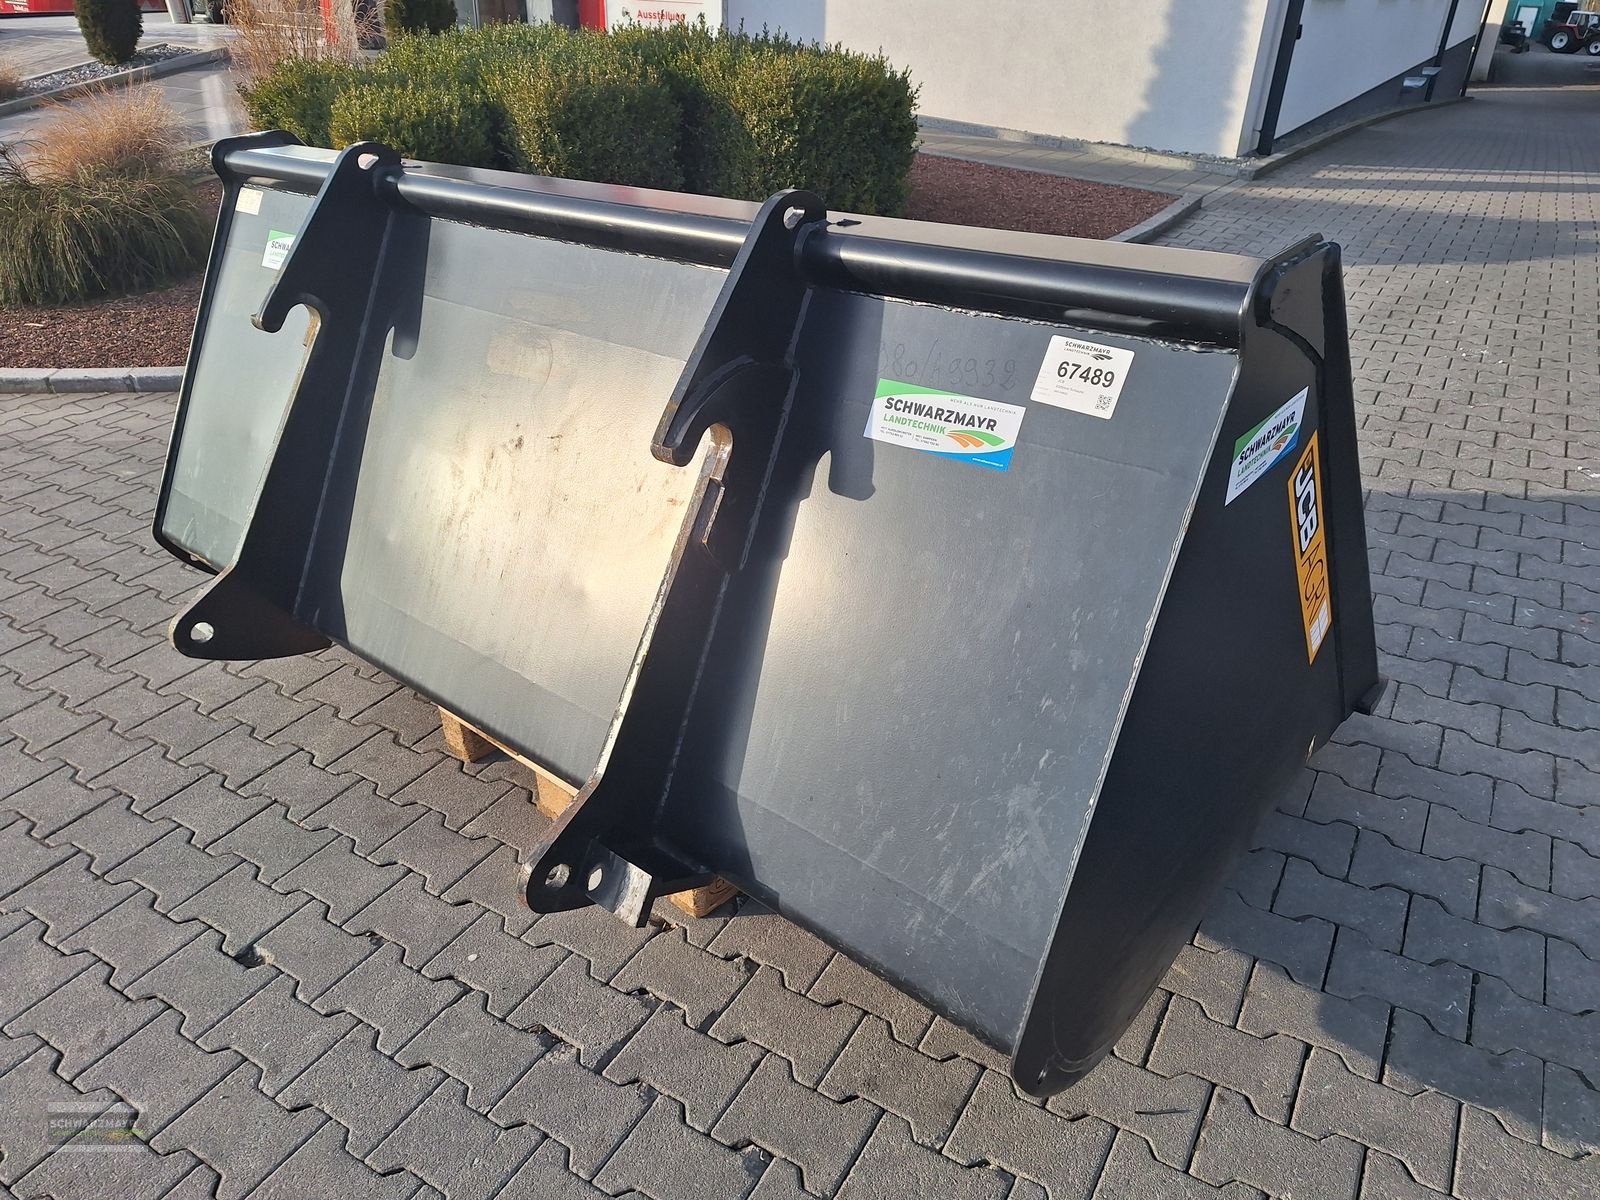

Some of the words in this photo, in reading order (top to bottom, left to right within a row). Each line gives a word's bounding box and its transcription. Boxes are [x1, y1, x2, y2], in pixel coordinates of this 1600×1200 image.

[1065, 341, 1110, 354] SCHWARZMAYR
[1057, 361, 1115, 388] 67489
[883, 413, 946, 435] LANDTECHNIK
[884, 397, 997, 432] SCHWARZMAYR
[1238, 410, 1296, 465] SCHWARZMAYR
[1295, 466, 1318, 552] JCB
[1302, 540, 1326, 625] AGRI
